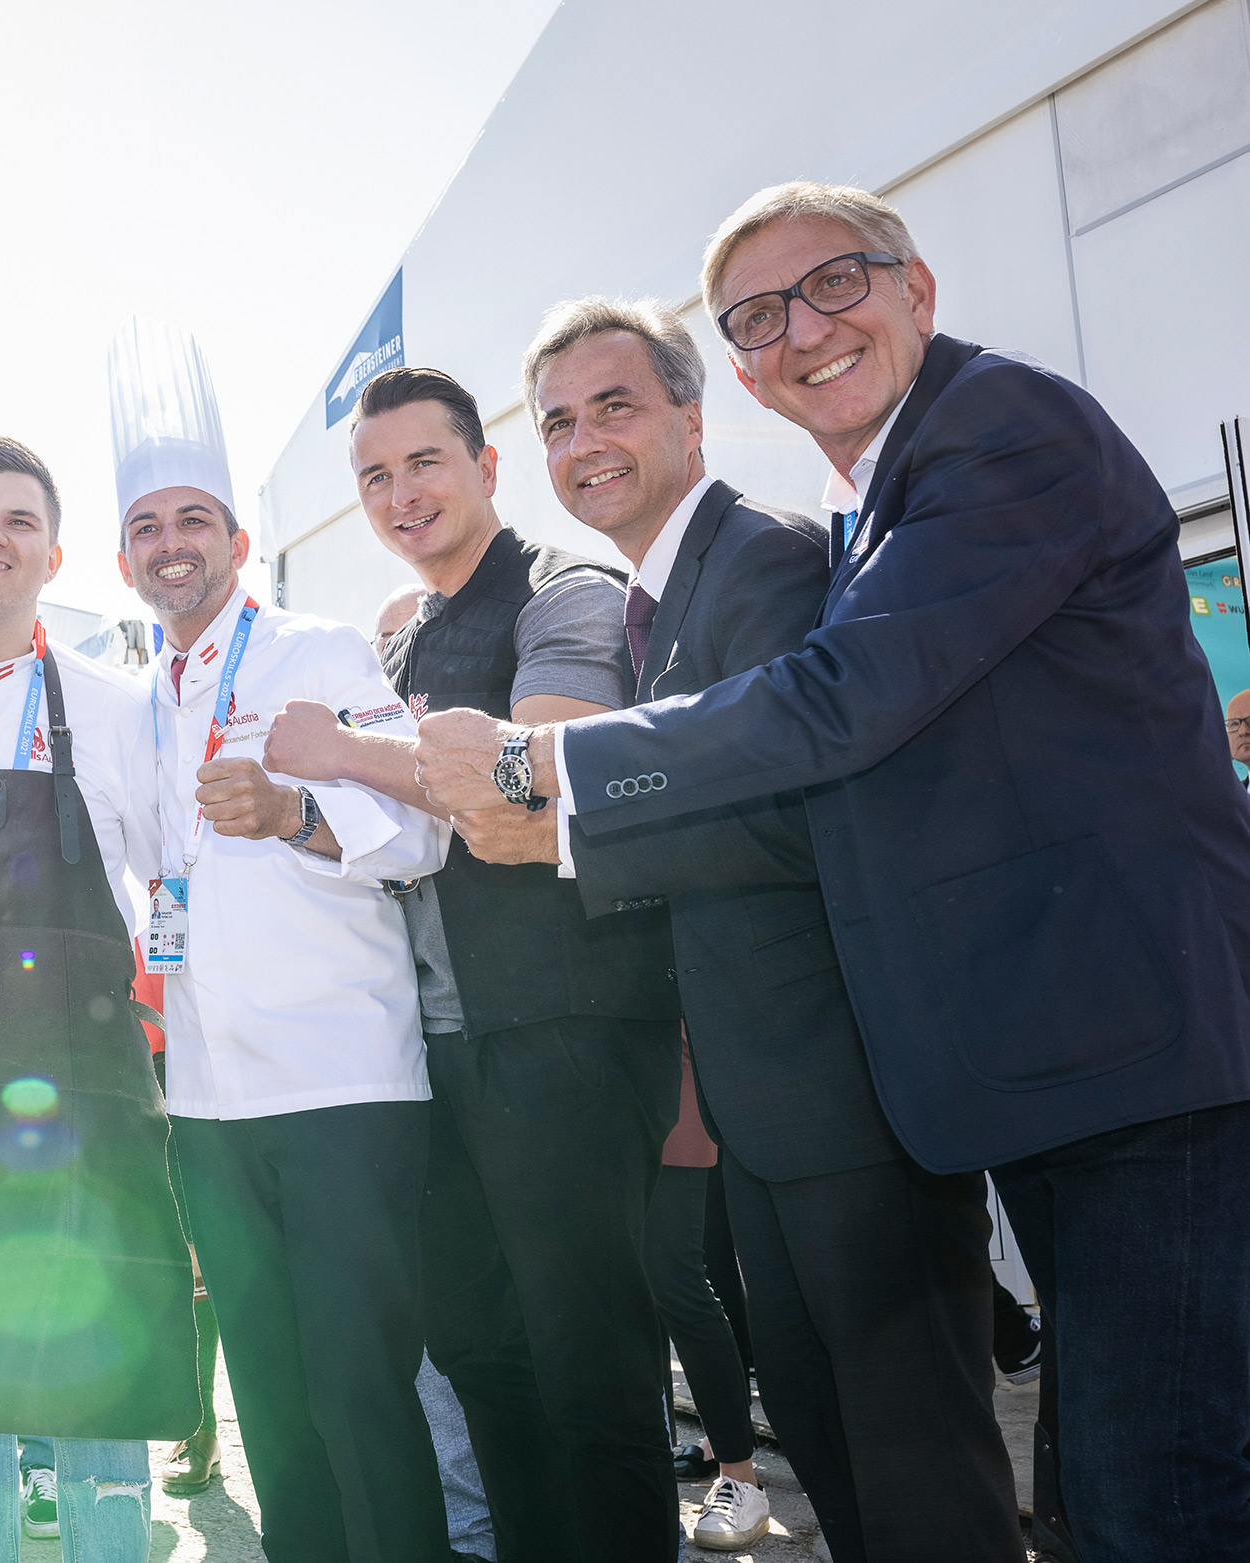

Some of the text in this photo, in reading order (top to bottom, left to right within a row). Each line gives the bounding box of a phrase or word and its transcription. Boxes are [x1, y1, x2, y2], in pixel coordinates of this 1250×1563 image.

[355, 334, 401, 385] EBERSTEINER
[224, 631, 246, 680] EUROSKILLS
[23, 687, 39, 737] EUROSKILLS
[220, 681, 230, 702] 2021
[19, 737, 30, 756] 2021
